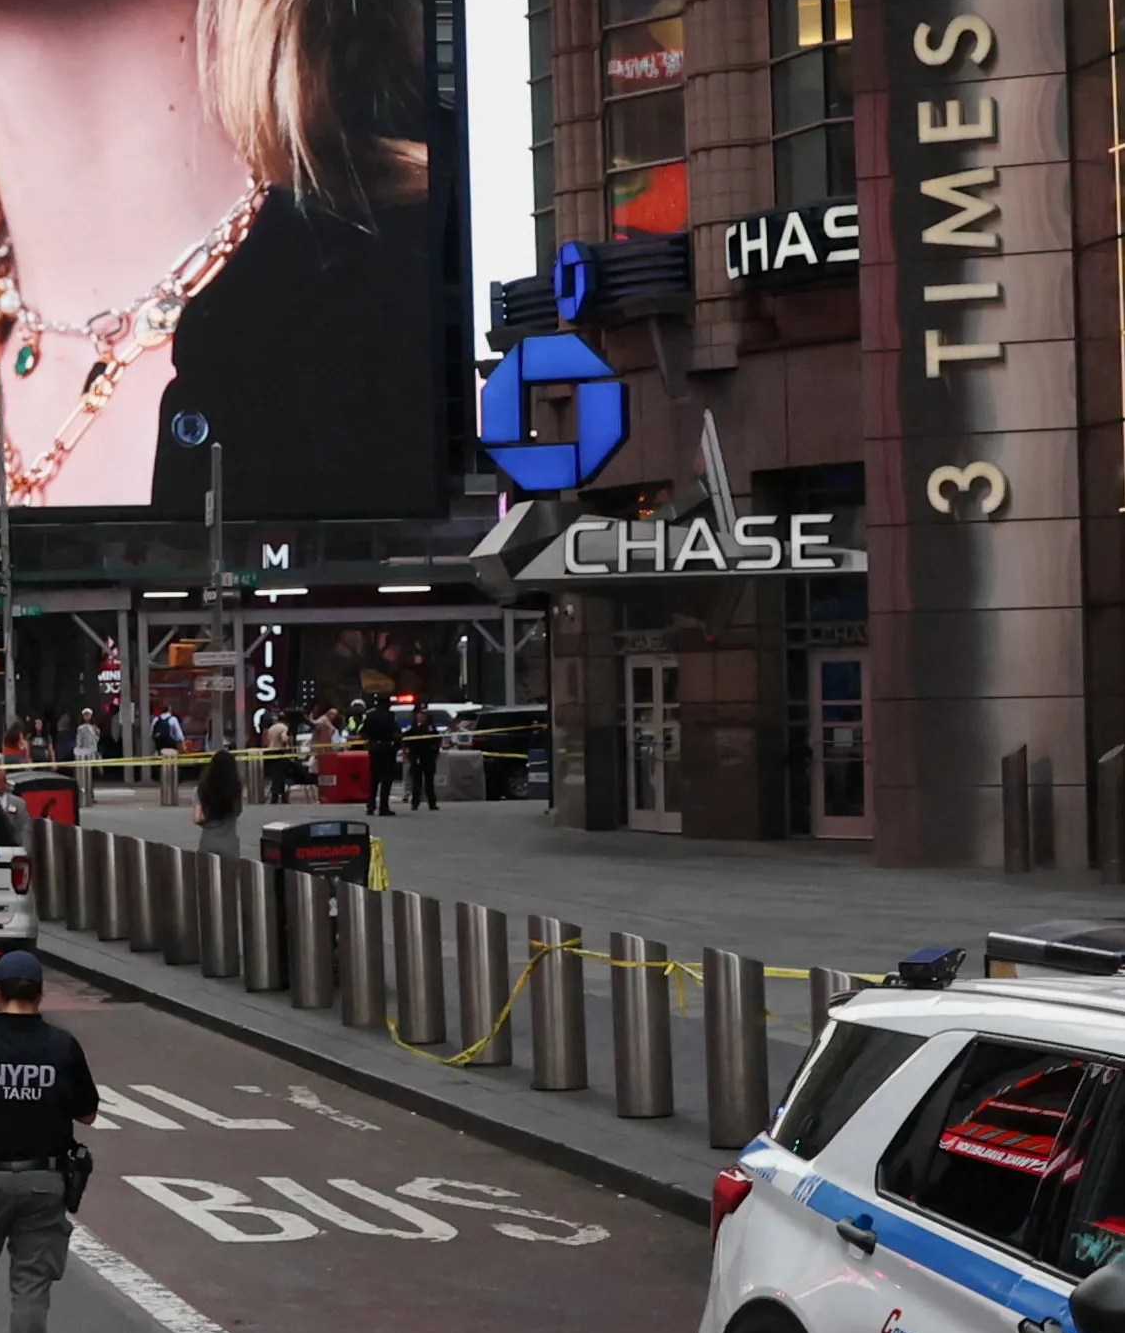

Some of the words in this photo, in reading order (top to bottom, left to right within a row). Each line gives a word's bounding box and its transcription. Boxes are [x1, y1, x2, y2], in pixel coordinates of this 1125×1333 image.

[914, 13, 1006, 378] TIMES
[725, 203, 860, 280] CHAS
[927, 461, 1008, 516] 3
[564, 513, 835, 574] CHASE
[2, 1087, 43, 1101] TARU
[121, 1175, 612, 1246] BUS
